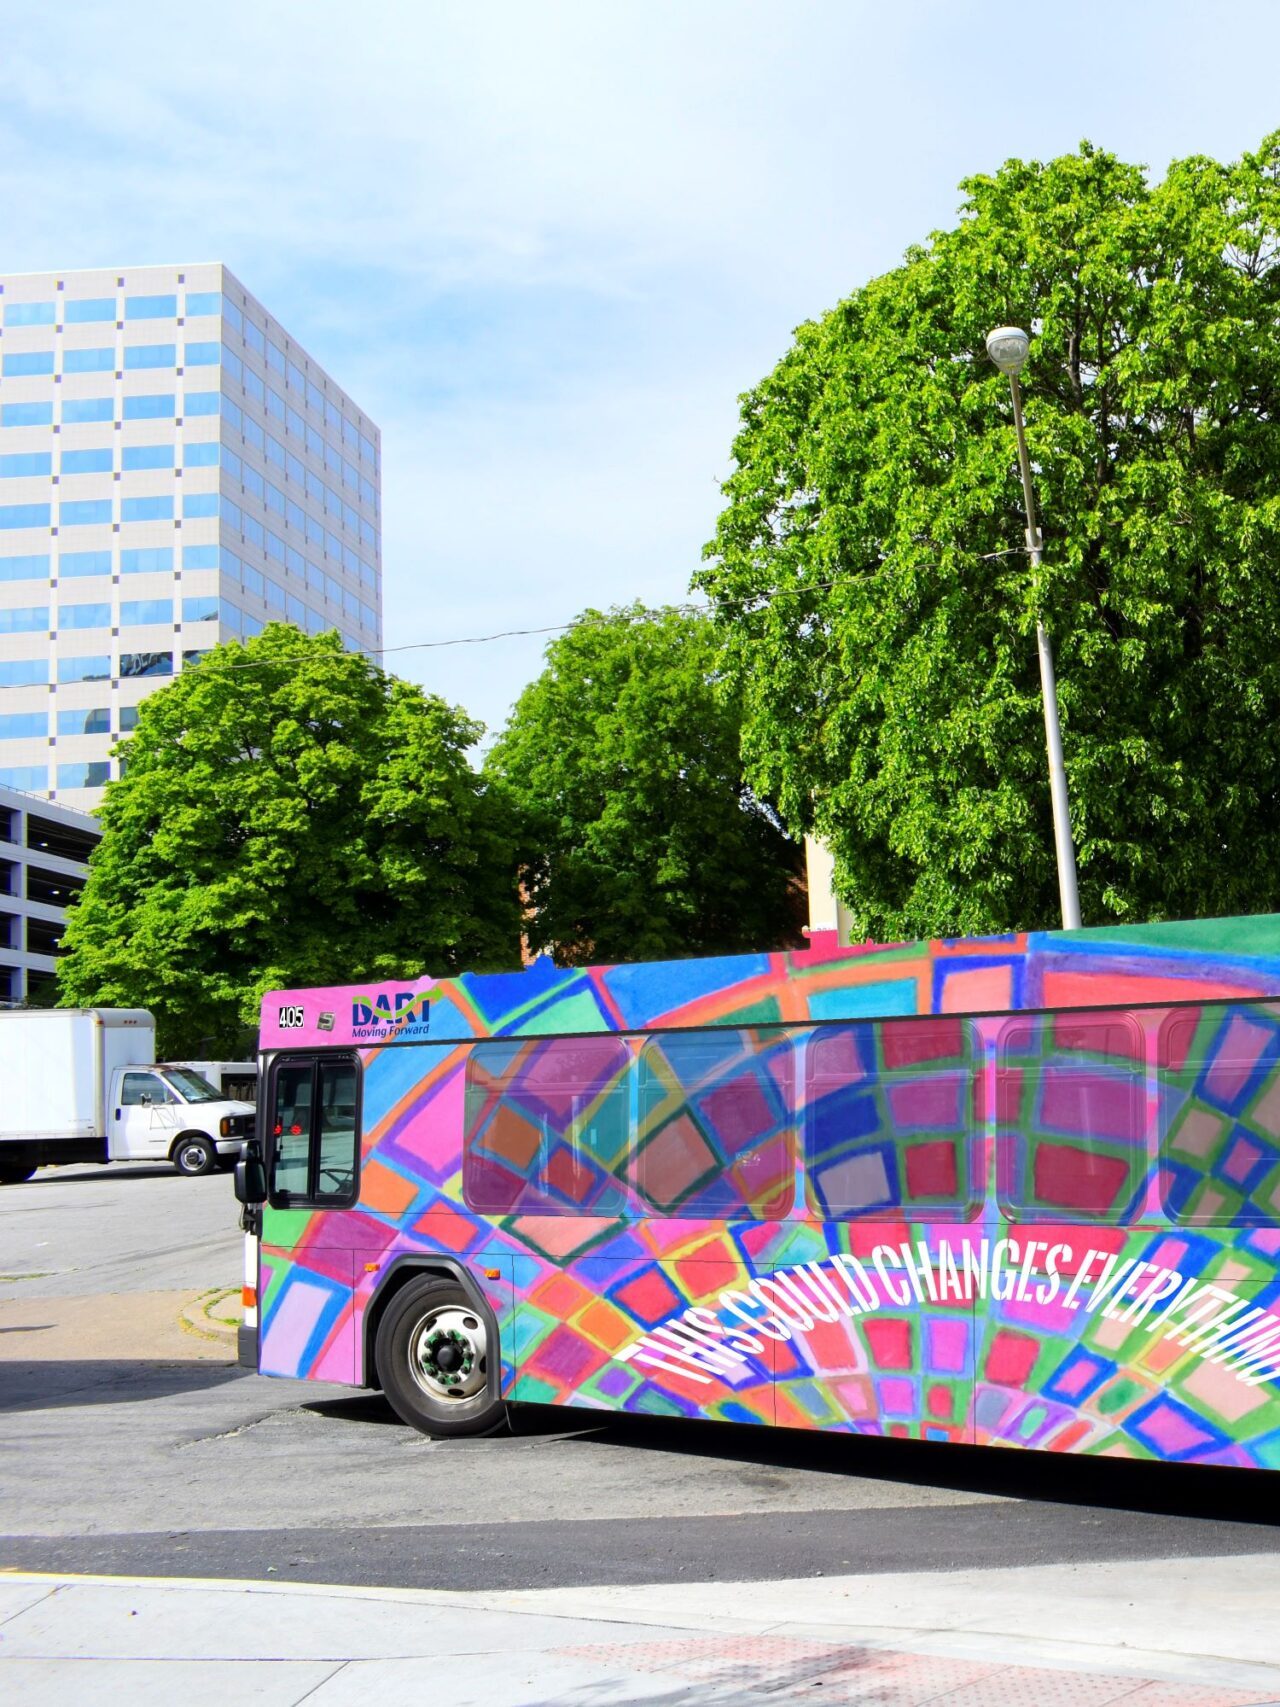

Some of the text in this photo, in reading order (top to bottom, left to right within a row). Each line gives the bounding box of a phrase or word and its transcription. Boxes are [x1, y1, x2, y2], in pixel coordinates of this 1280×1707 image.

[279, 1006, 304, 1028] 405
[352, 988, 443, 1026] DART
[352, 1024, 430, 1039] Moving Forward
[612, 1307, 765, 1384] THIS
[718, 1254, 880, 1342] COULD
[871, 1239, 1073, 1306] CHANGES
